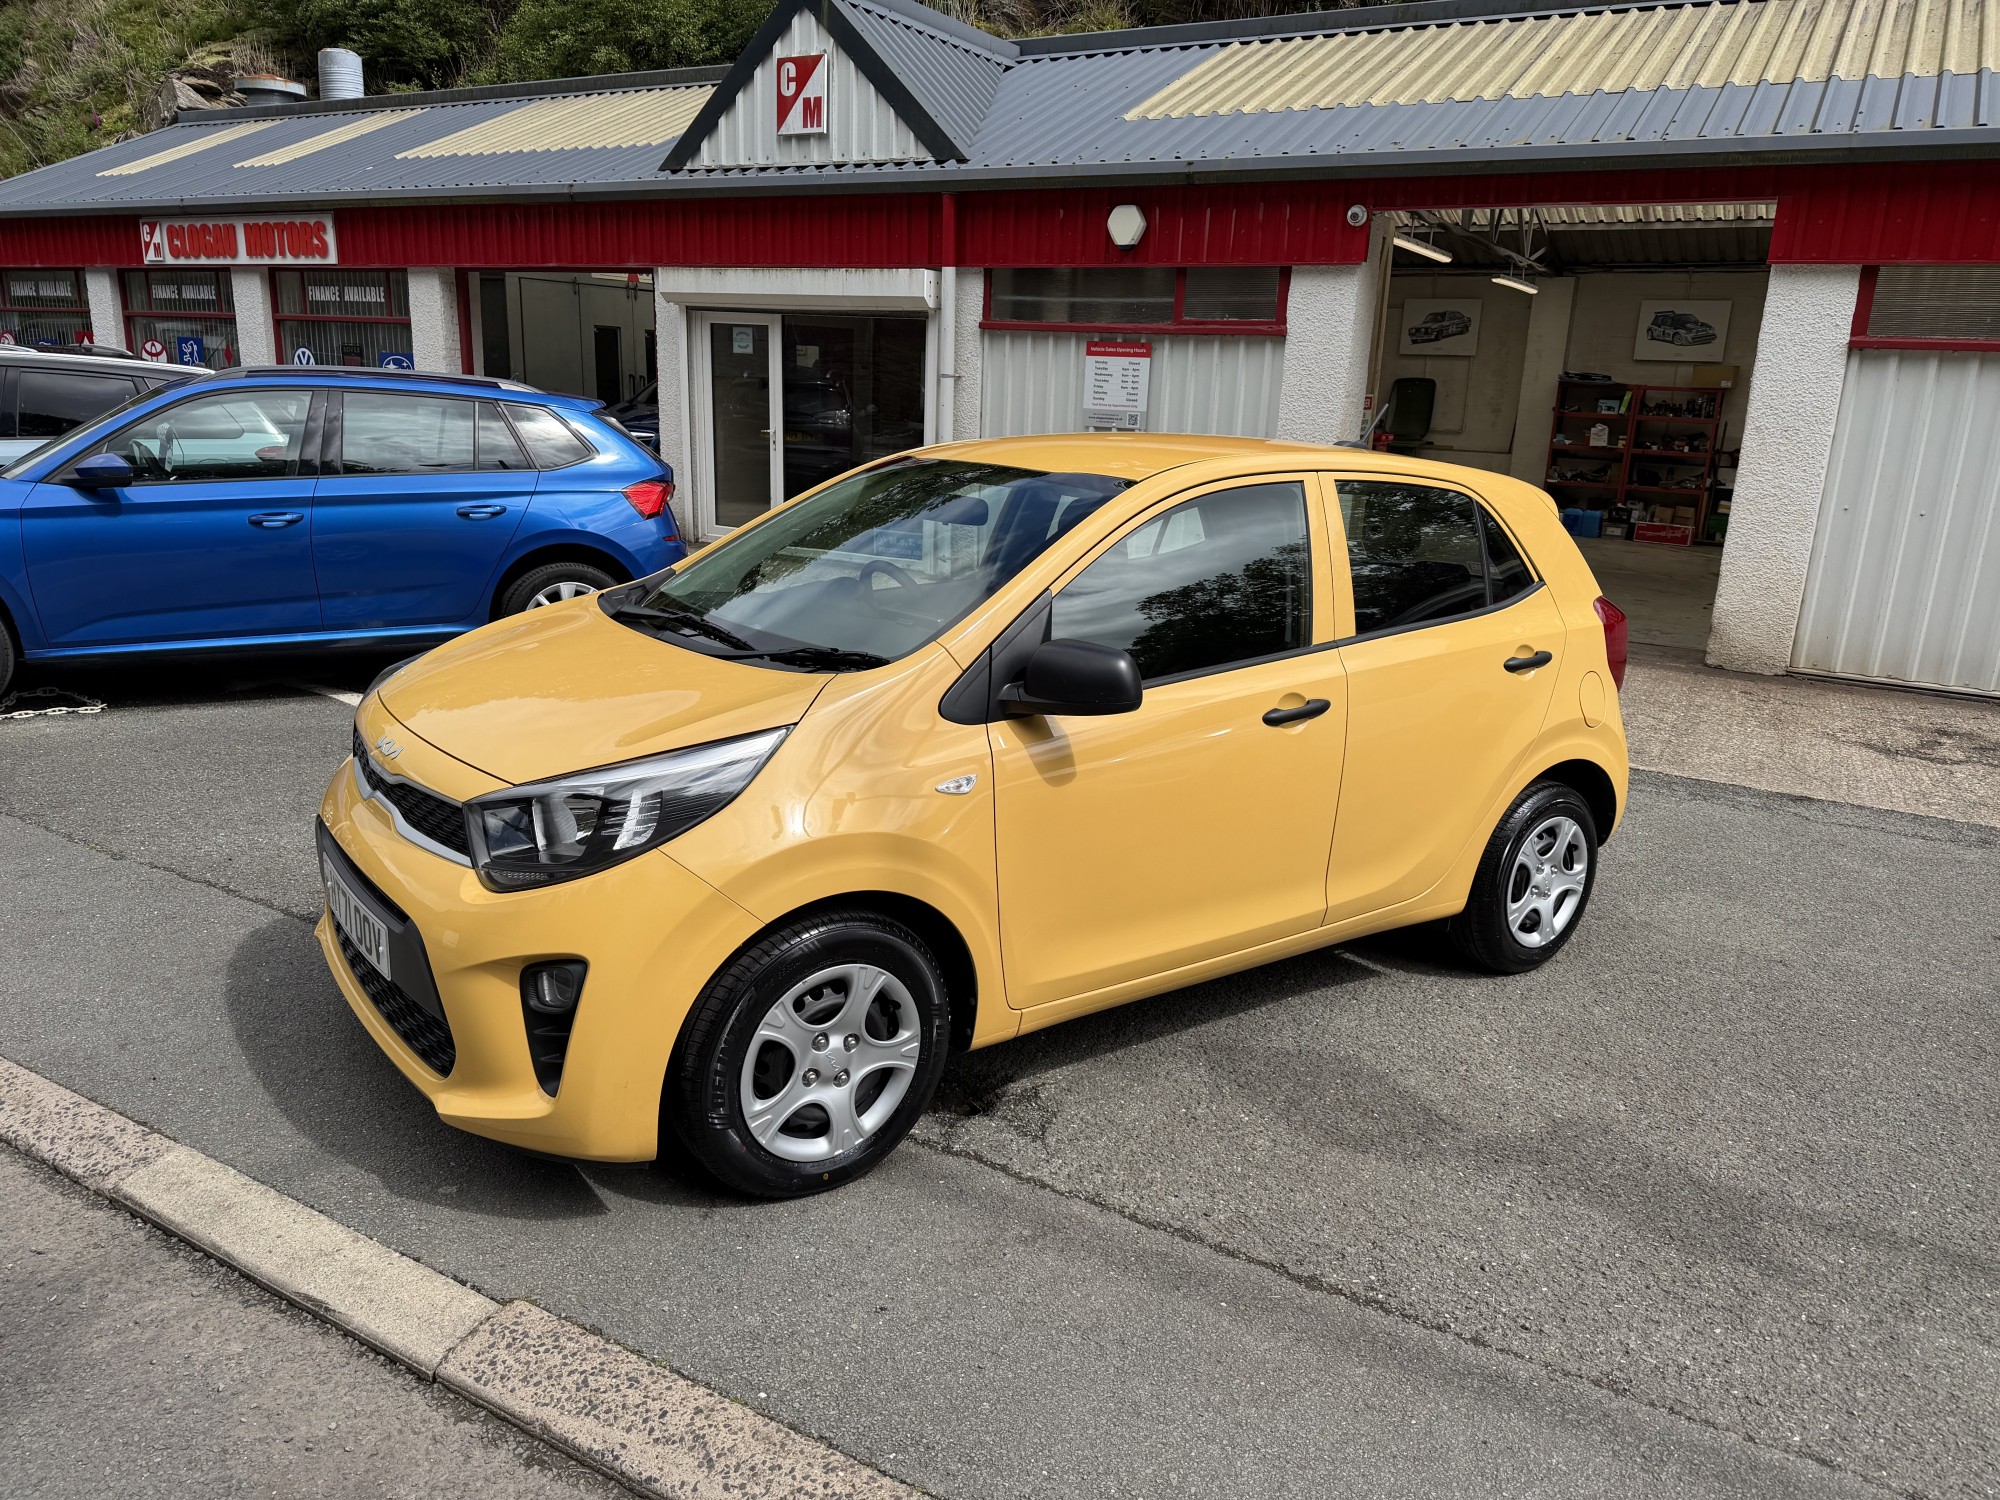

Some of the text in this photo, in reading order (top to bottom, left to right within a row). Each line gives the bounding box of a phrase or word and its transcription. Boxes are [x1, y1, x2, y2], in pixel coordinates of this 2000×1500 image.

[781, 61, 797, 97] C
[802, 96, 822, 128] M
[166, 221, 328, 259] CLOGAU MOTORS
[10, 281, 72, 297] FINANCE AVAILABLE
[152, 284, 216, 300] FINANCE AVAILABLE
[308, 286, 385, 302] FINANCE AVAILABLE
